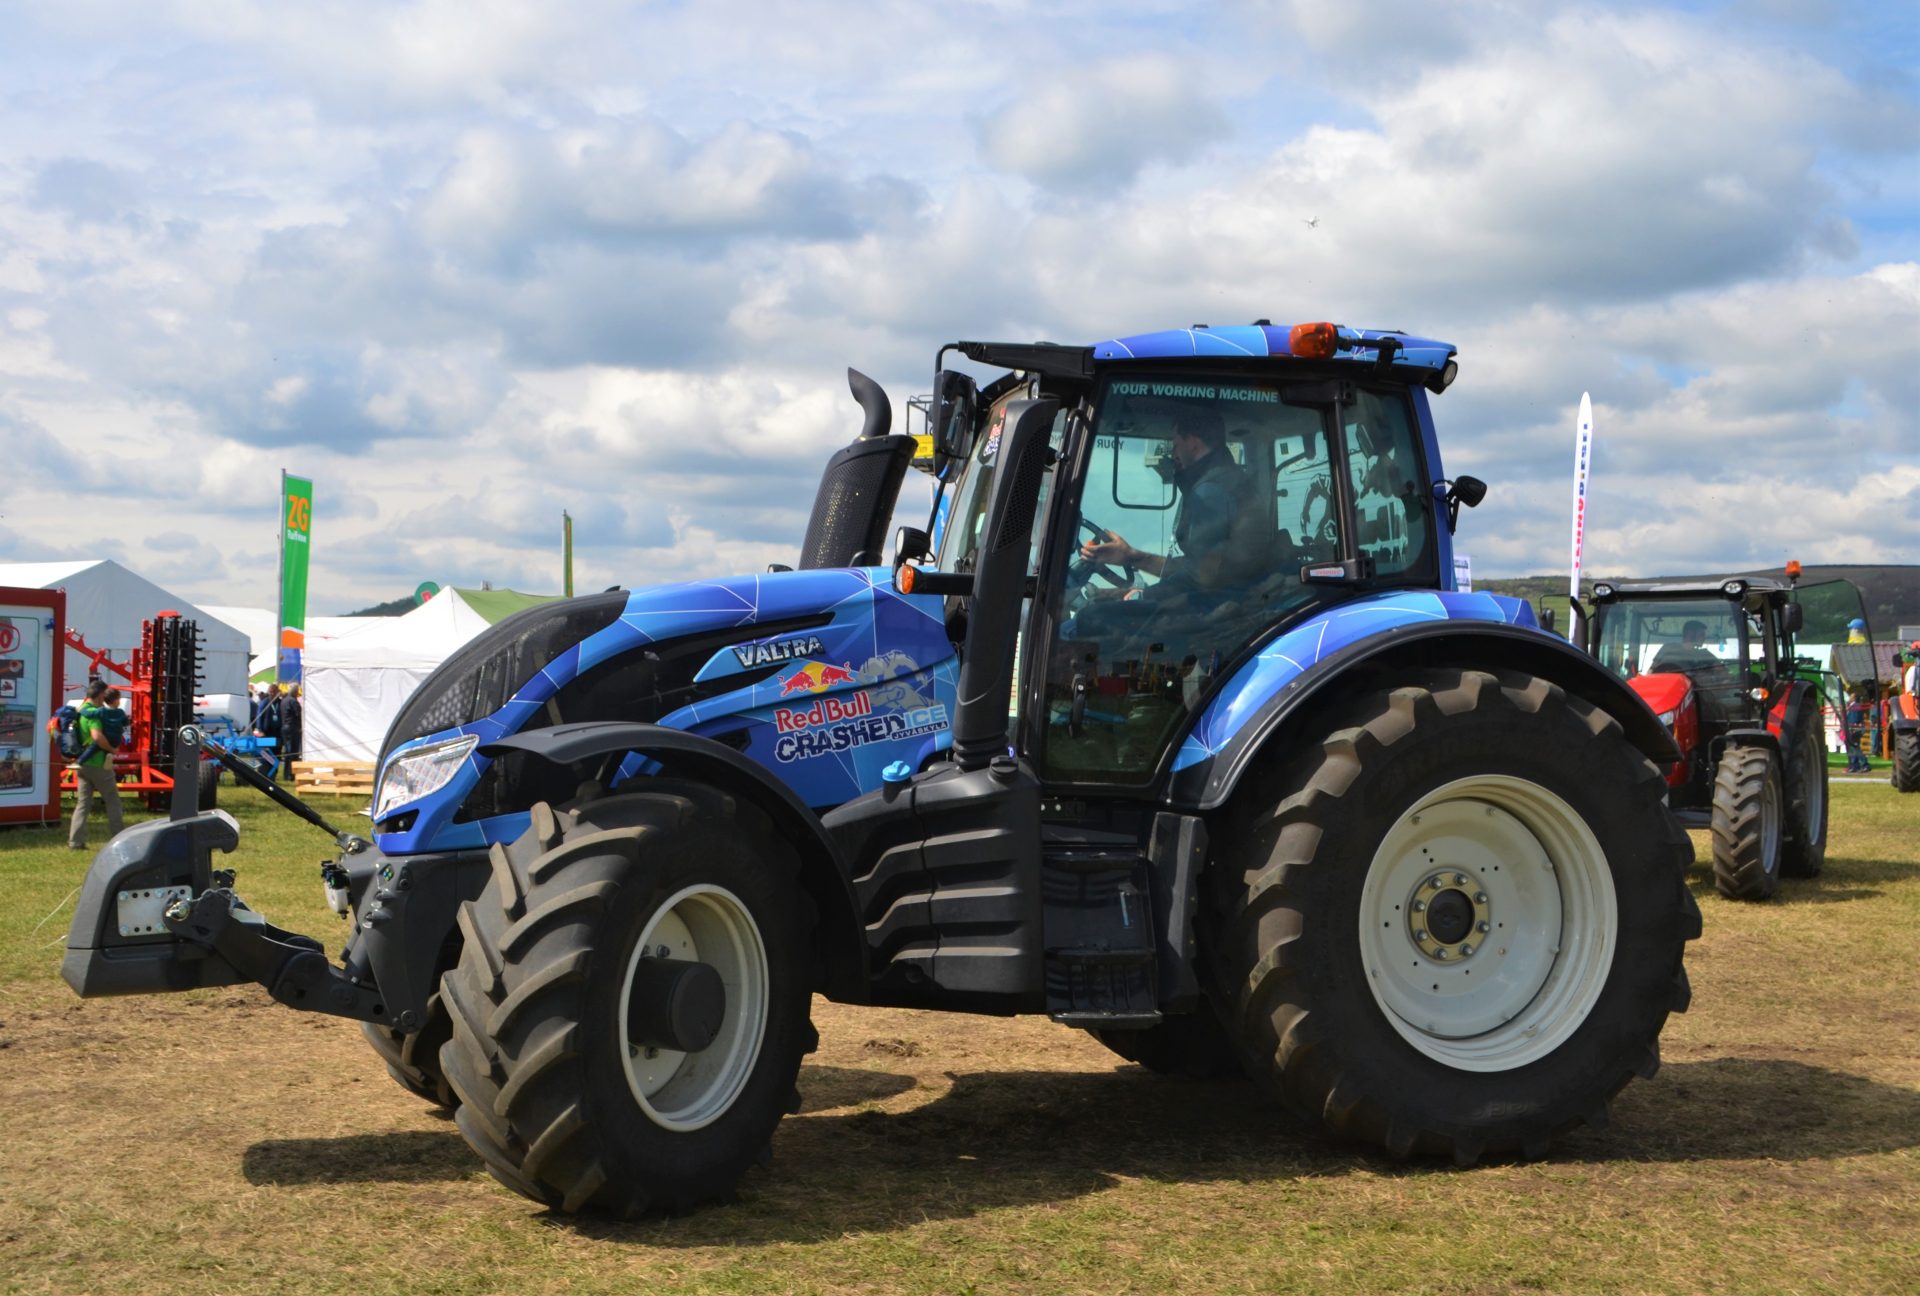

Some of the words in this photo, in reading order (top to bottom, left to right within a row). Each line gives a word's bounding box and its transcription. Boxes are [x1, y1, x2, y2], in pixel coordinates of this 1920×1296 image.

[1112, 383, 1149, 396] YOUR
[1152, 384, 1216, 399] WORKING
[1219, 388, 1280, 403] MACHINE
[288, 496, 309, 531] ZG
[734, 636, 825, 668] VALTRA
[775, 702, 823, 734] Red
[825, 690, 872, 722] Bull
